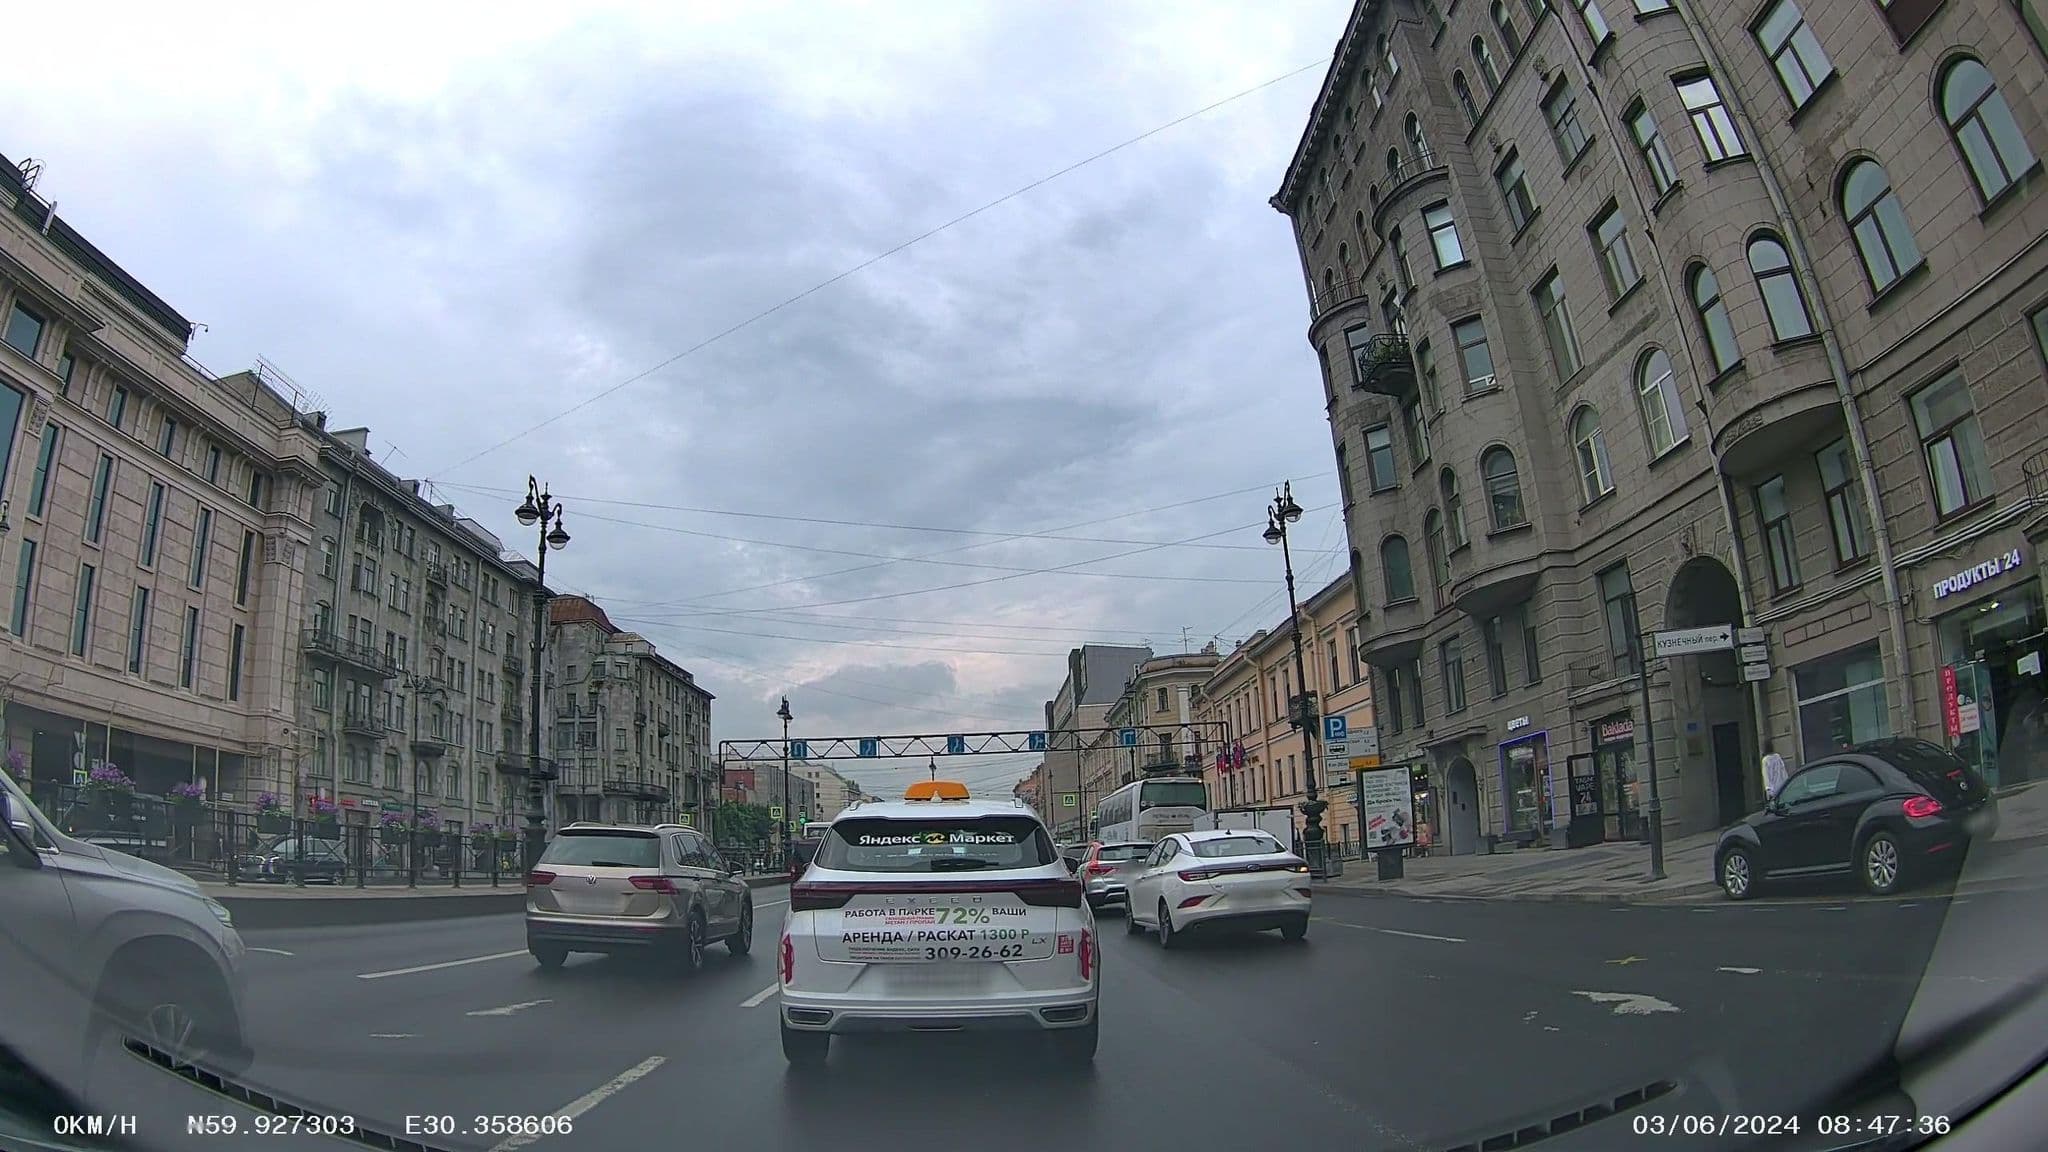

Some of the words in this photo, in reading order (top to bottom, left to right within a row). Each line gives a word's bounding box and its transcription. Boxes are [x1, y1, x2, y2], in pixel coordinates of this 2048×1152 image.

[1933, 557, 1999, 599] ПРОДУКТЫ
[2003, 549, 2021, 570] 24
[1656, 634, 1703, 649] КУЗНЕЧНЫЙ
[859, 834, 921, 845] Яндекс
[949, 833, 1015, 845] Маркет
[844, 908, 887, 918] РАБОТА
[889, 908, 896, 916] В
[898, 907, 936, 917] ПАРКЕ
[936, 907, 990, 925] 72%
[992, 907, 1027, 916] ВАШИ
[842, 931, 904, 944] АРЕНДА
[907, 930, 914, 942] /
[917, 929, 976, 941] РАСКАТ
[980, 929, 1017, 940] 1300
[925, 943, 1023, 961] 309-26-62
